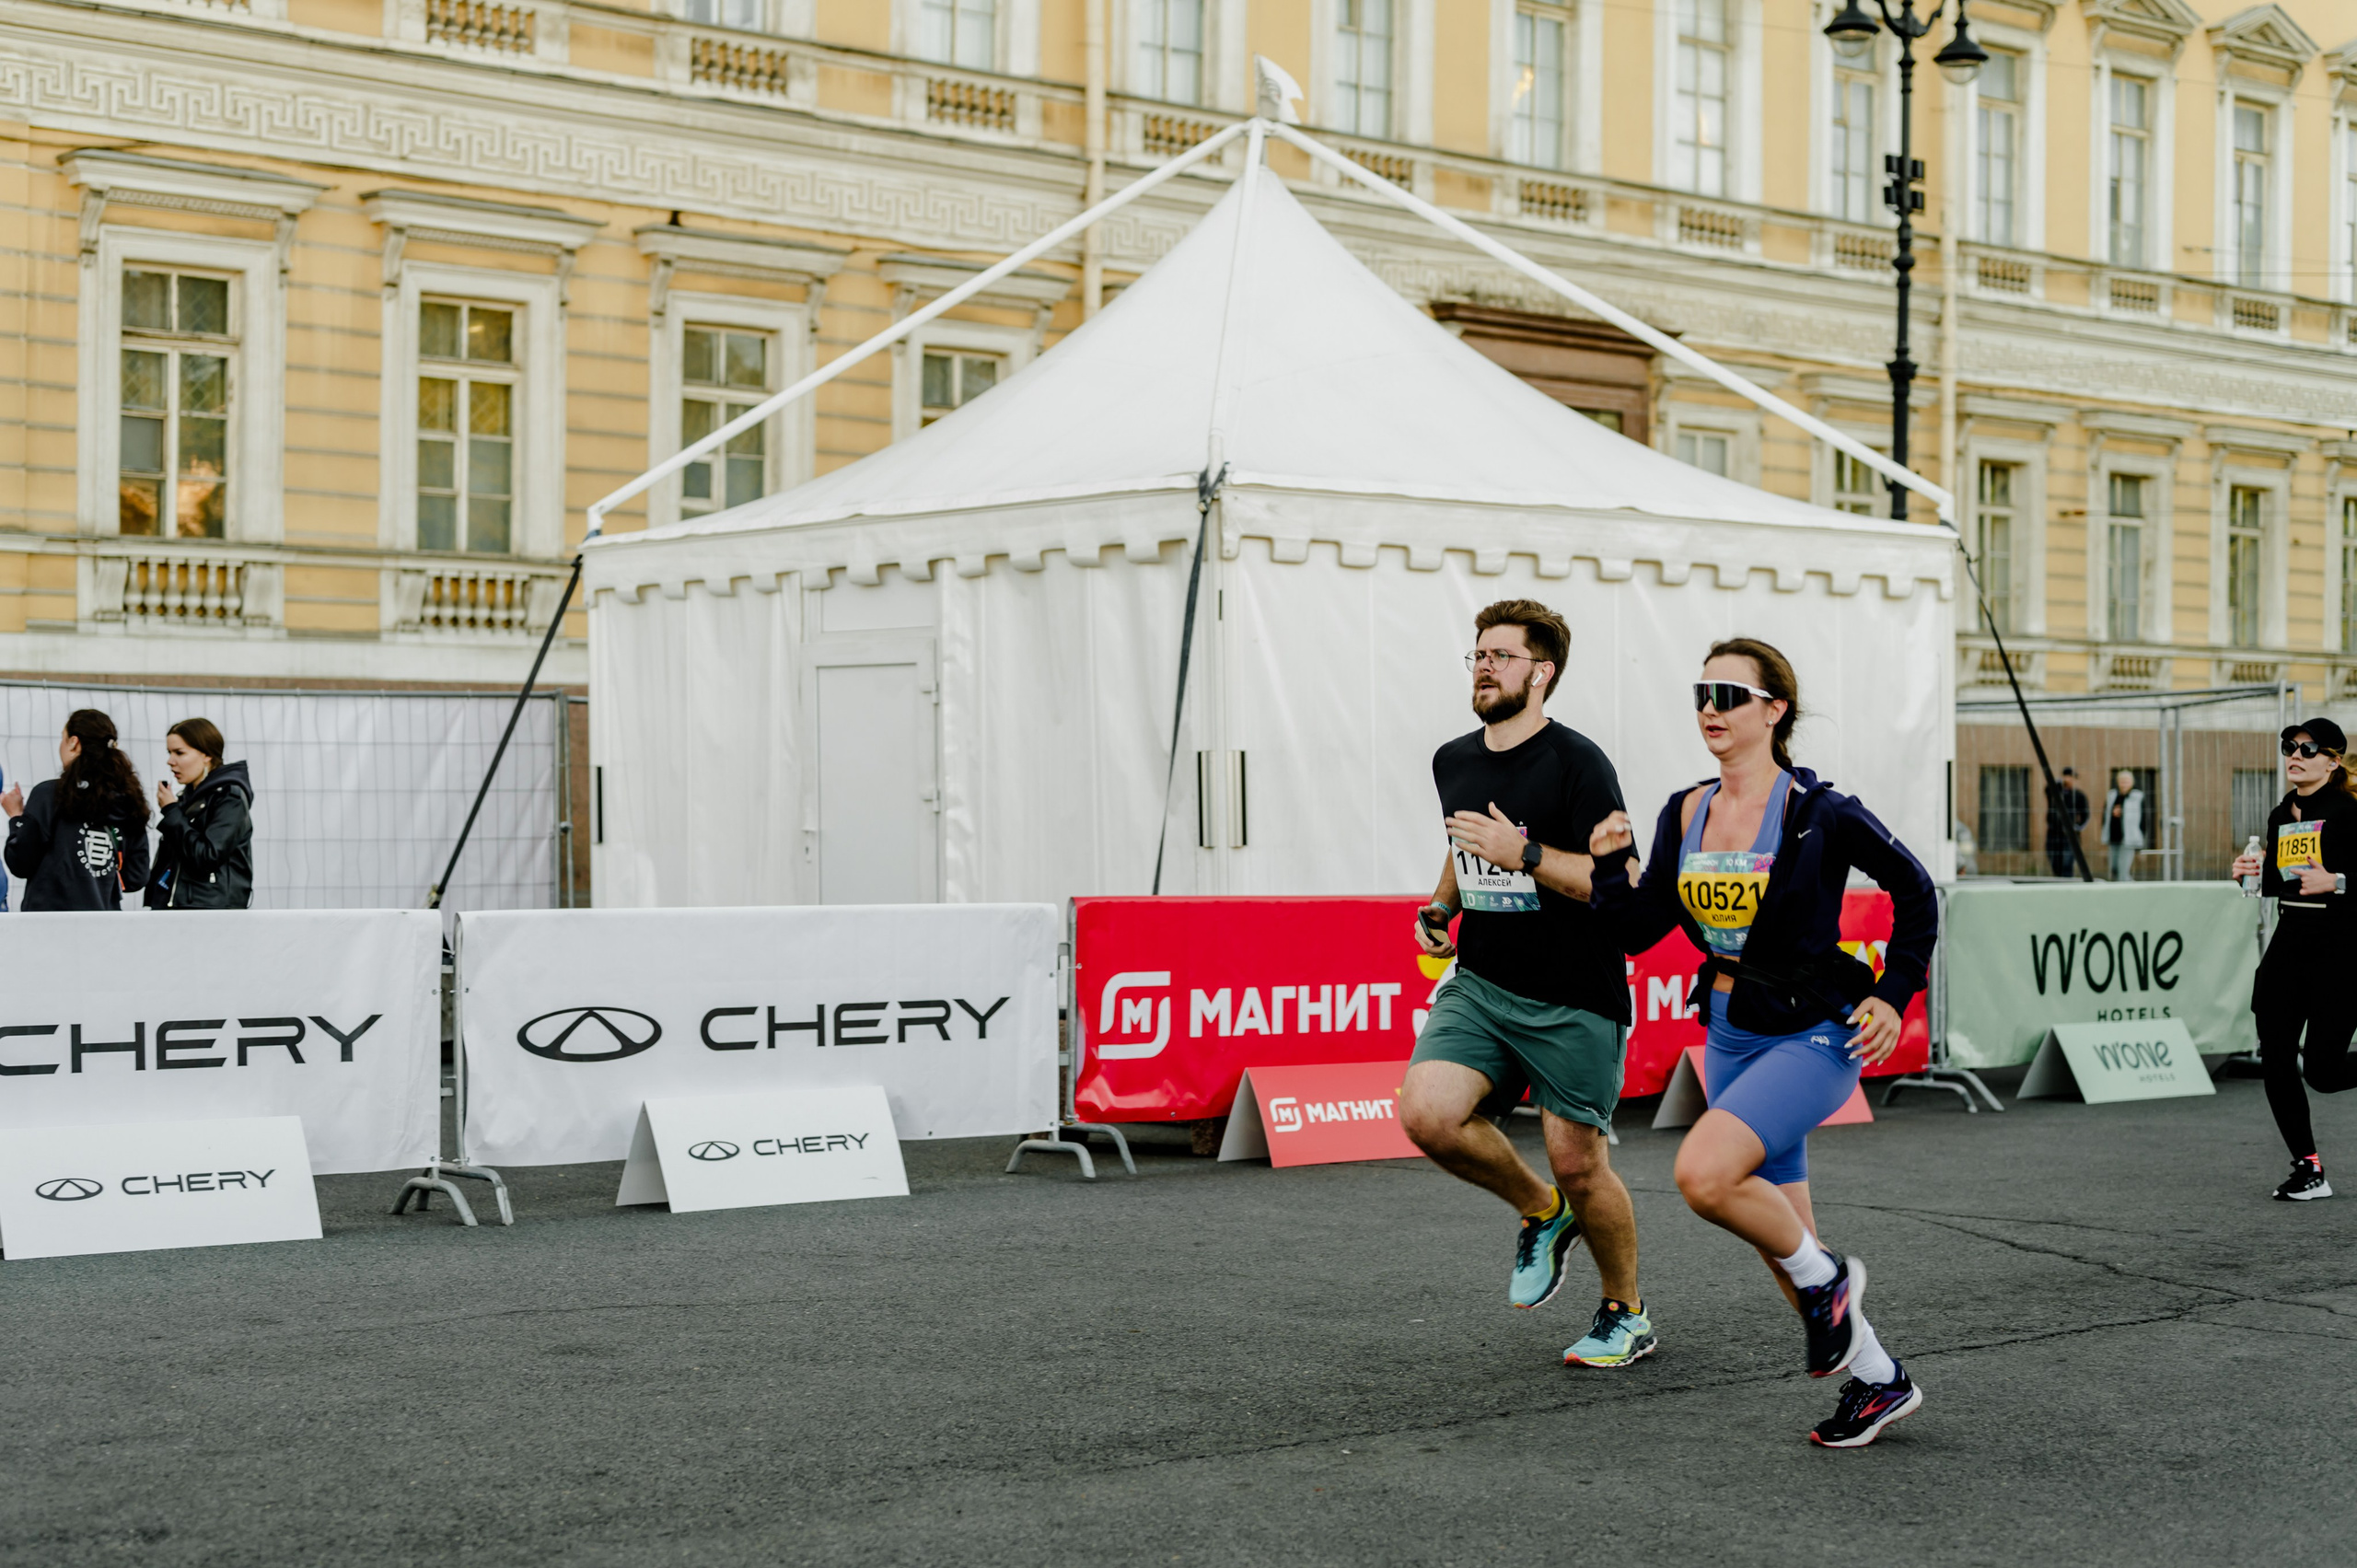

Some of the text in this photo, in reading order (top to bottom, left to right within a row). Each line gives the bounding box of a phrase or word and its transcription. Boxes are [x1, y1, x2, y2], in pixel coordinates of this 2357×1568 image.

[2280, 837, 2316, 858] 11851
[1478, 877, 1512, 887] АЛЕКСЕЙ
[1466, 892, 1476, 907] D
[1682, 880, 1762, 912] 10521
[1712, 913, 1737, 923] ЮЛИЯ
[1189, 982, 1401, 1038] МАГНИТ
[700, 996, 1011, 1051] CHERY
[0, 1014, 383, 1076] CHERY
[2139, 1073, 2176, 1083] HOTELS
[1305, 1098, 1394, 1123] МАГНИТ
[753, 1132, 869, 1156] CHERY
[121, 1168, 276, 1196] CHERY
